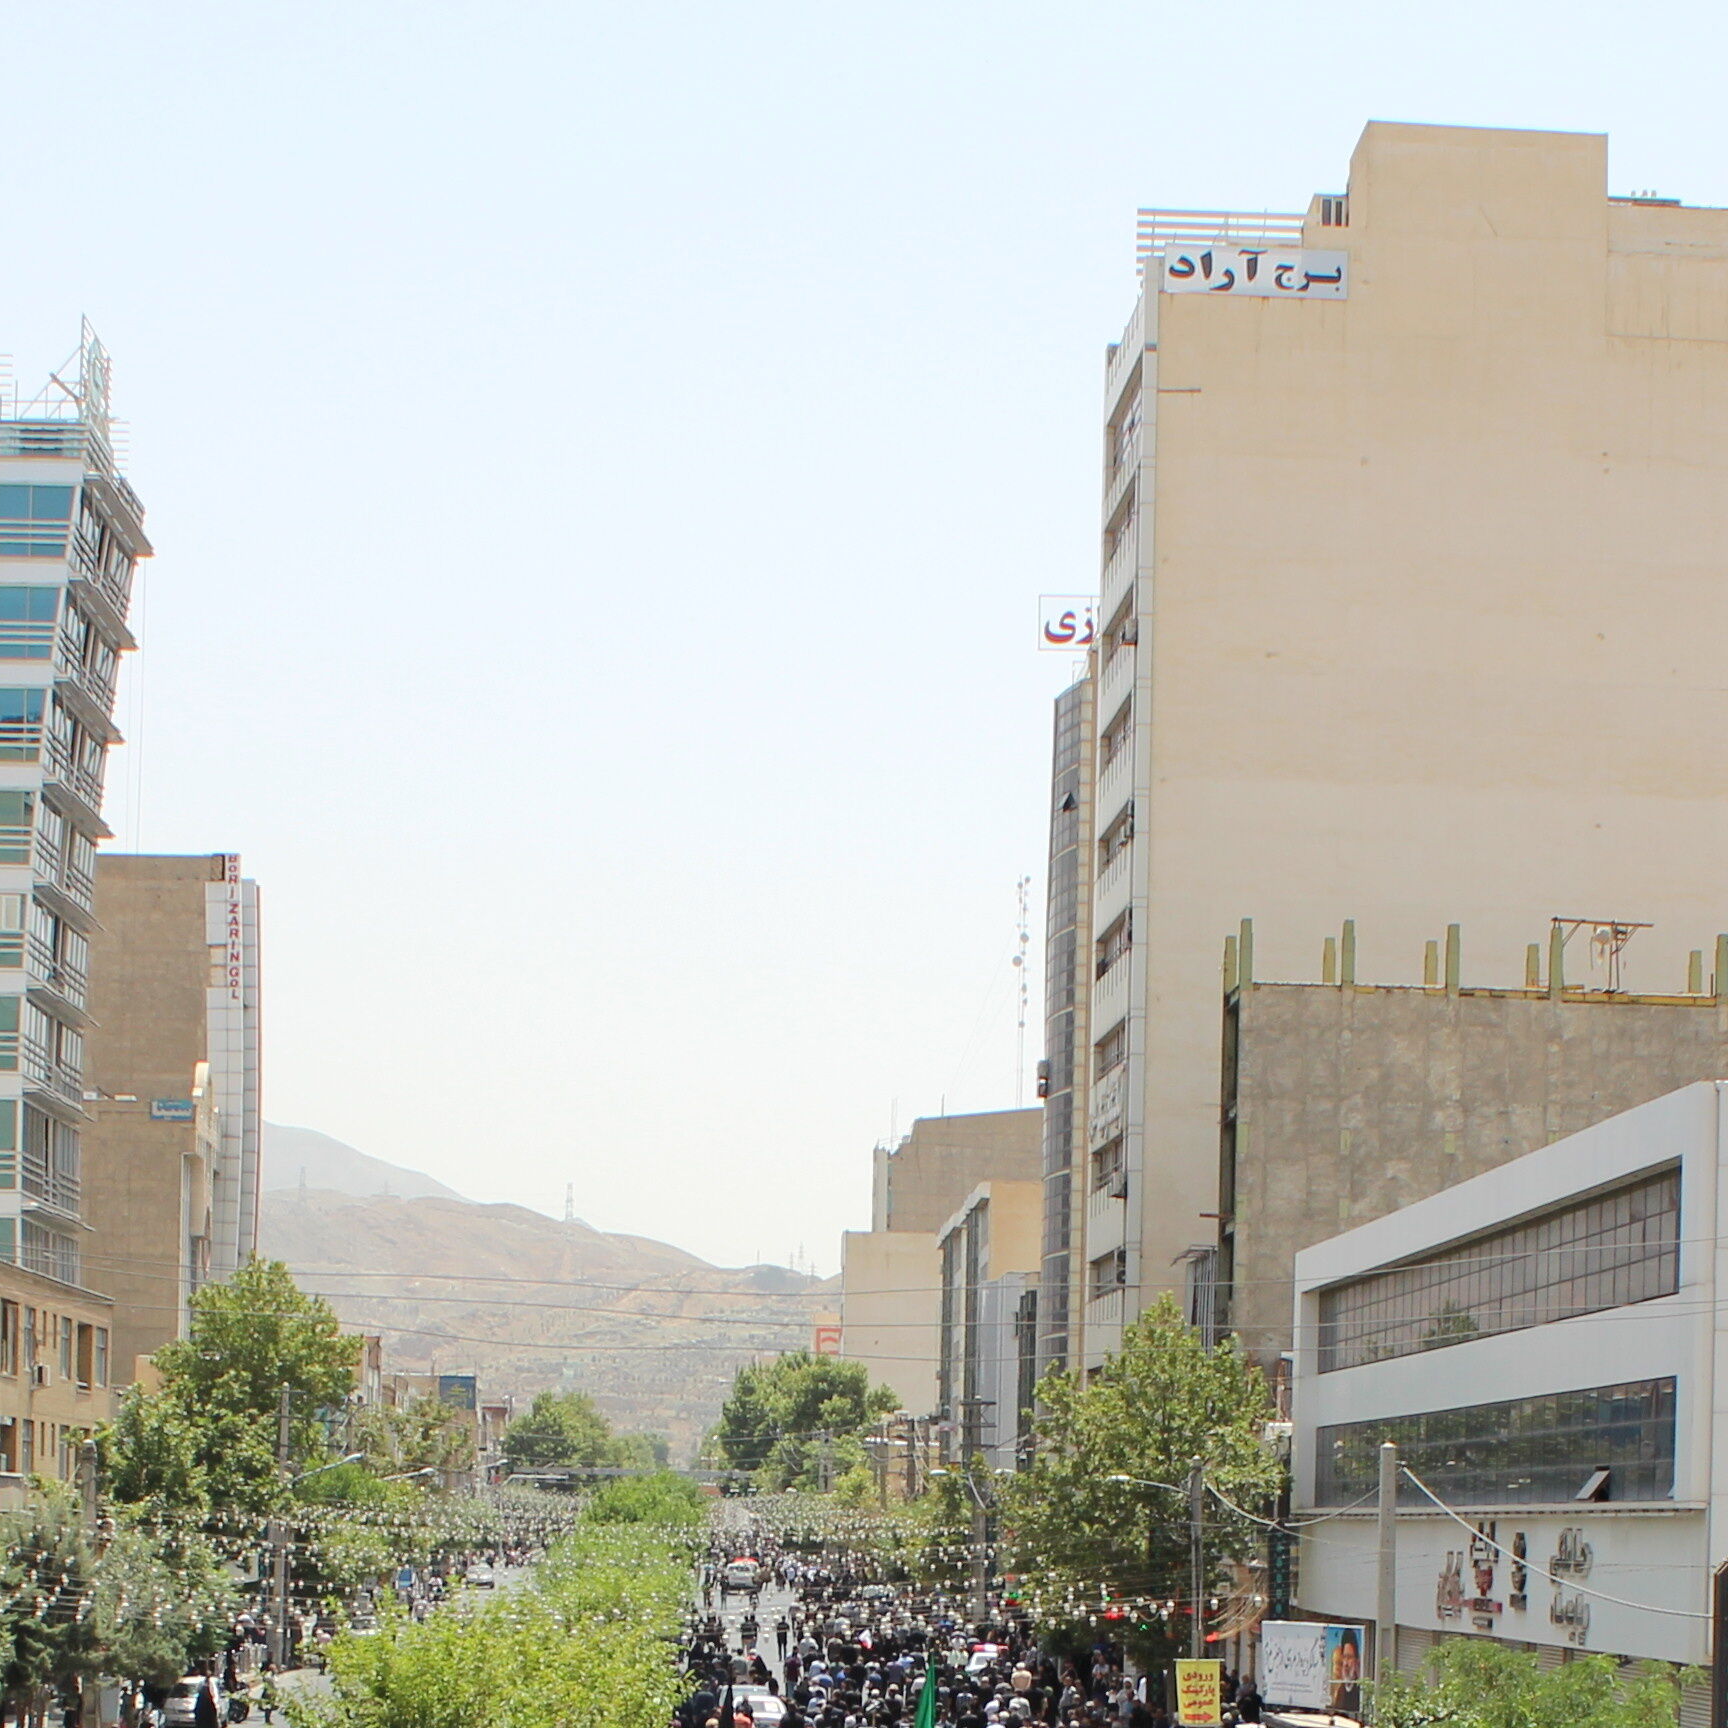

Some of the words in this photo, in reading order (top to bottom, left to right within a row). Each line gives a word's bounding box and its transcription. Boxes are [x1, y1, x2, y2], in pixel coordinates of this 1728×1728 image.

[1167, 248, 1269, 292] آراد
[1274, 260, 1342, 293] برج
[228, 902, 240, 962] ZARIN
[228, 966, 240, 1000] GOL
[1181, 1684, 1215, 1697] پارکینگ
[1182, 1671, 1214, 1682] ورودی
[1183, 1699, 1214, 1709] عمومی
